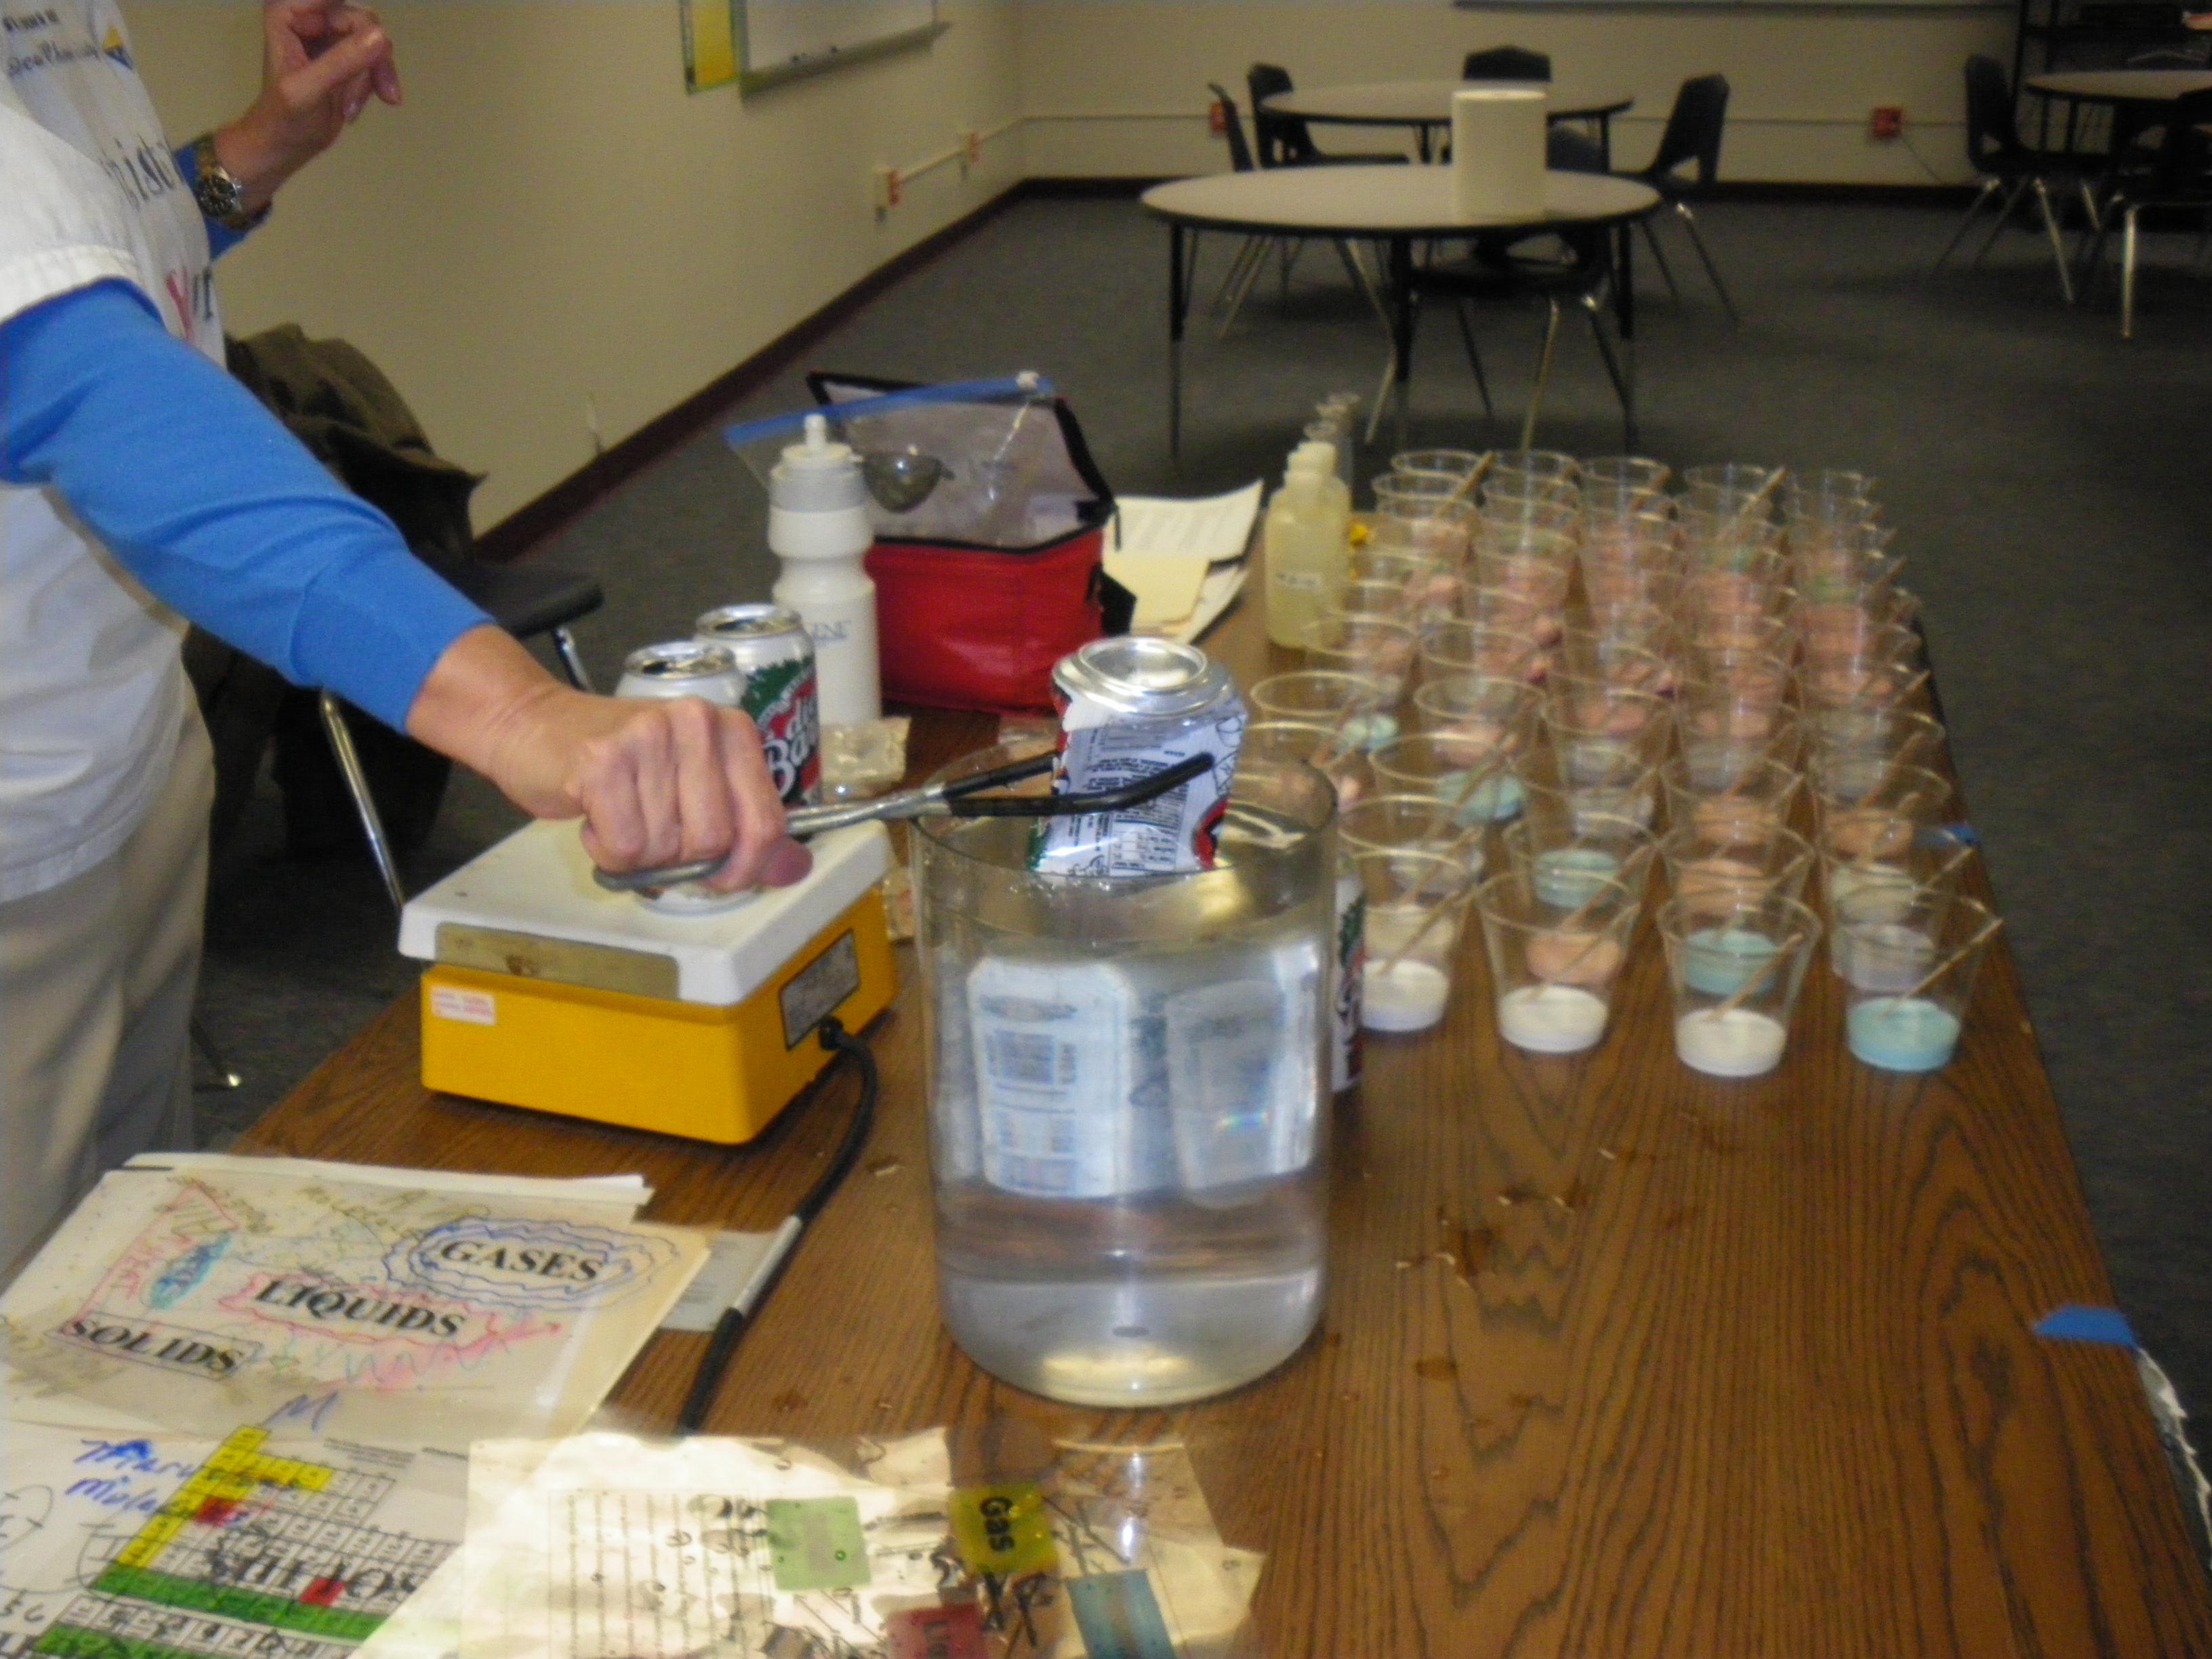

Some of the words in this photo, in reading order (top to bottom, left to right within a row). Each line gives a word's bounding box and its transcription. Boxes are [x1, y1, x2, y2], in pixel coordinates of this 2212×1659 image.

[441, 1238, 609, 1284] GASES
[253, 1279, 469, 1338] LIQUIDS
[68, 1318, 246, 1375] SOLIDS
[979, 1496, 1015, 1552] Gas
